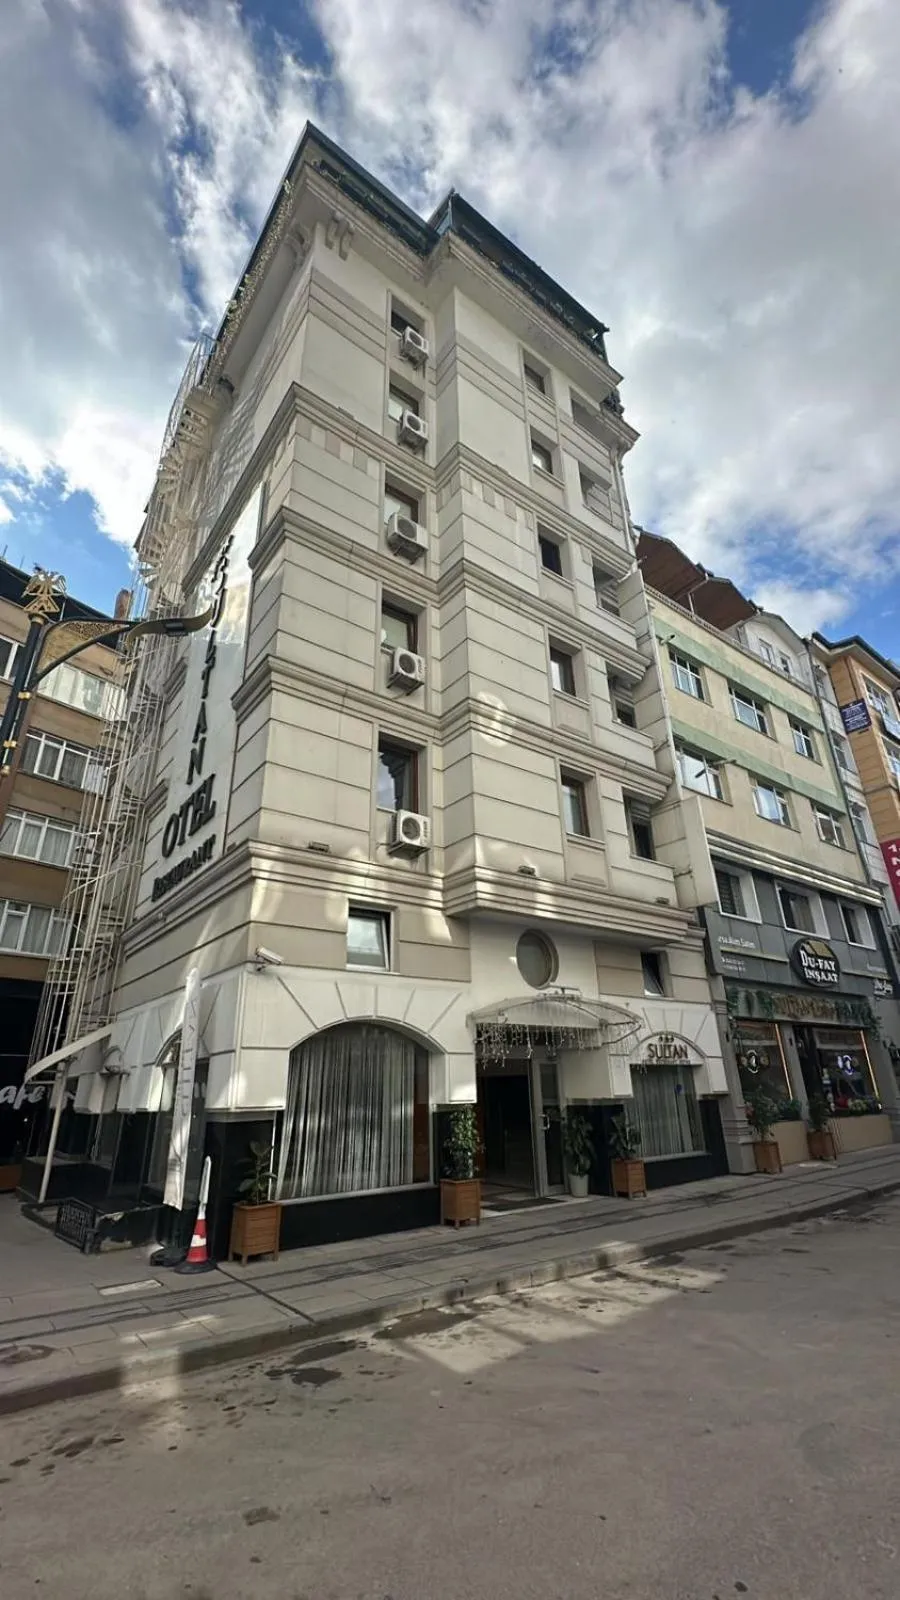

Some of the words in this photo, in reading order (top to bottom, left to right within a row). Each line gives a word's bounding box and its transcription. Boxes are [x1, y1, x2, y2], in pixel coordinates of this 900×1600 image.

[161, 773, 217, 858] OTEL
[799, 949, 836, 972] DU-FAY
[647, 1043, 689, 1059] SULTAN
